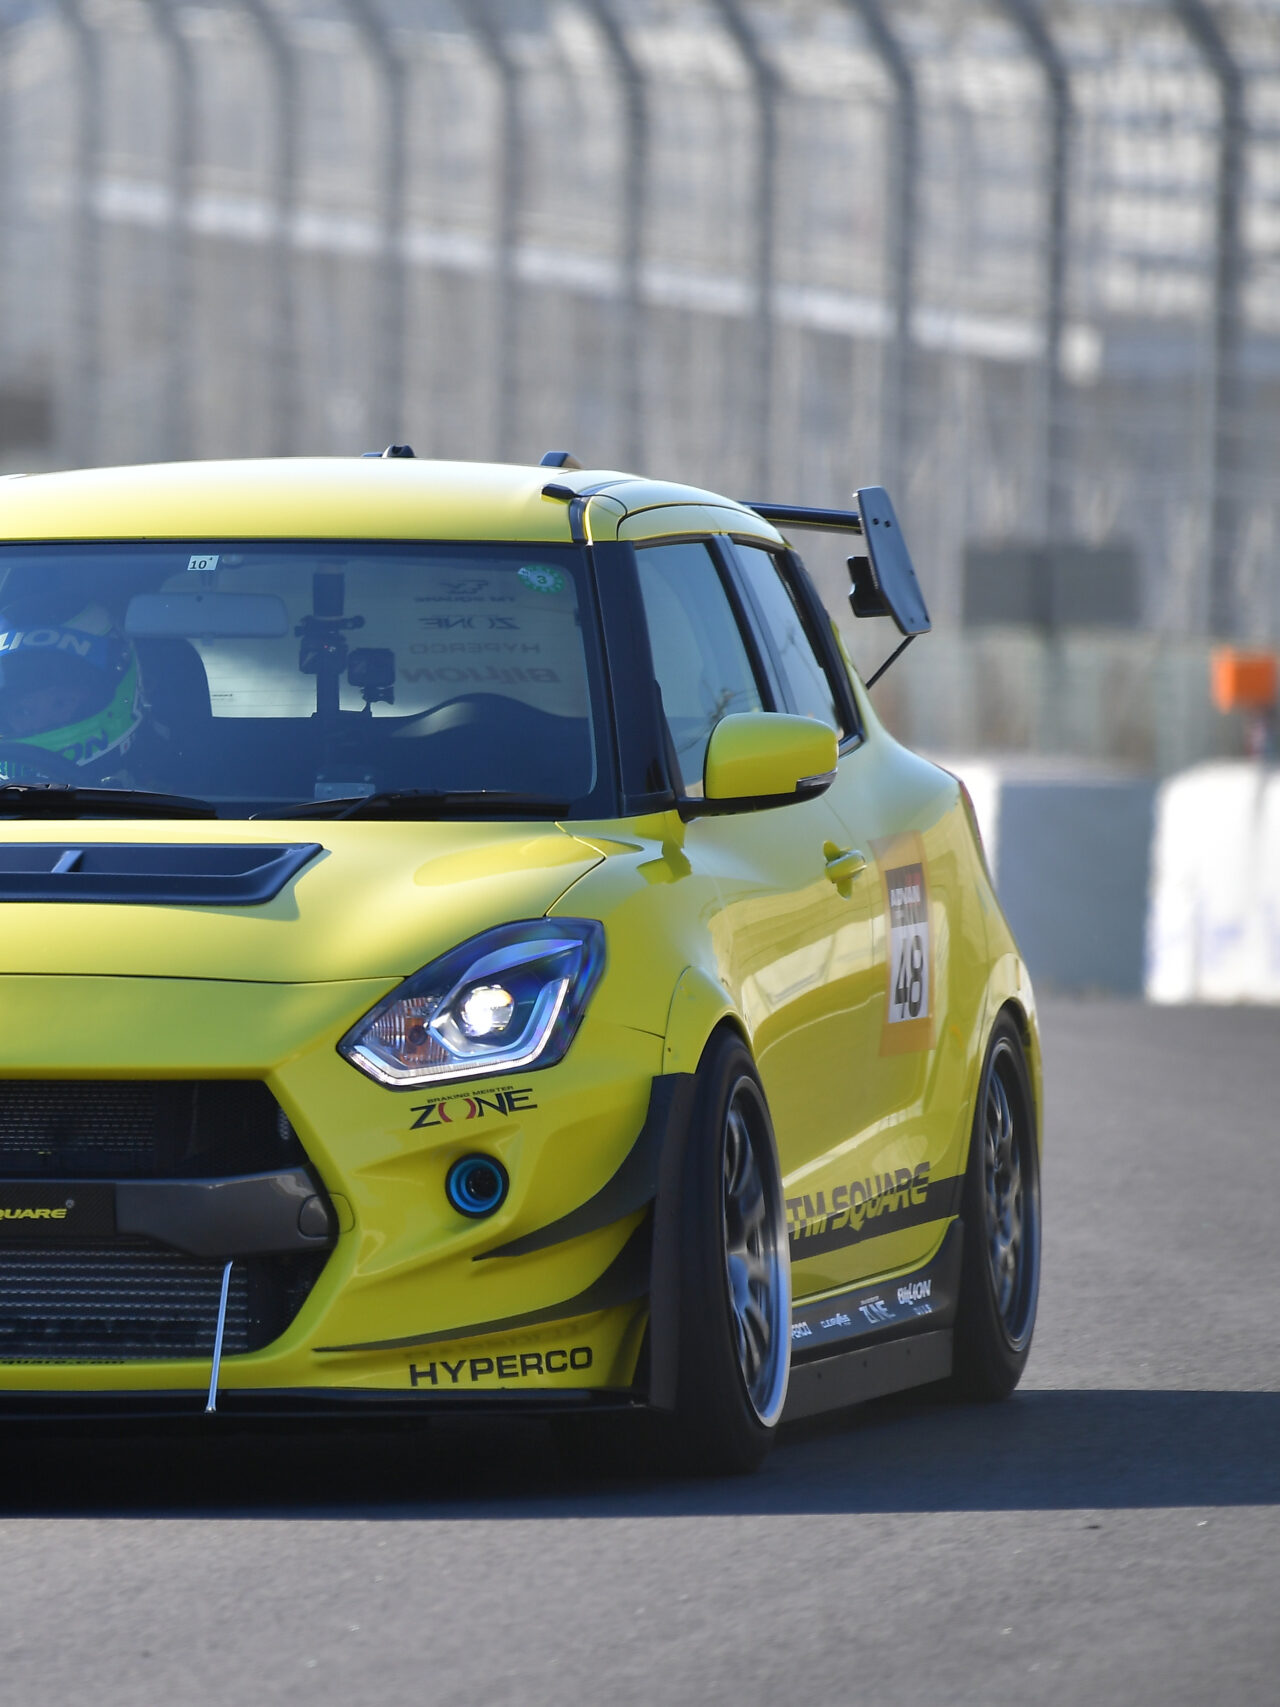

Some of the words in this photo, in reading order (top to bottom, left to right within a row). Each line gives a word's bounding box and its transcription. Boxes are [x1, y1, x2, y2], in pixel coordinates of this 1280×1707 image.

[189, 560, 208, 570] 10
[894, 935, 925, 1019] 48
[409, 1088, 538, 1130] ZONE
[427, 1092, 471, 1103] BRAKING
[472, 1085, 514, 1097] MEISTER
[785, 1191, 828, 1240] TM
[831, 1161, 931, 1232] SQUARE
[408, 1346, 594, 1387] HYPERCO
